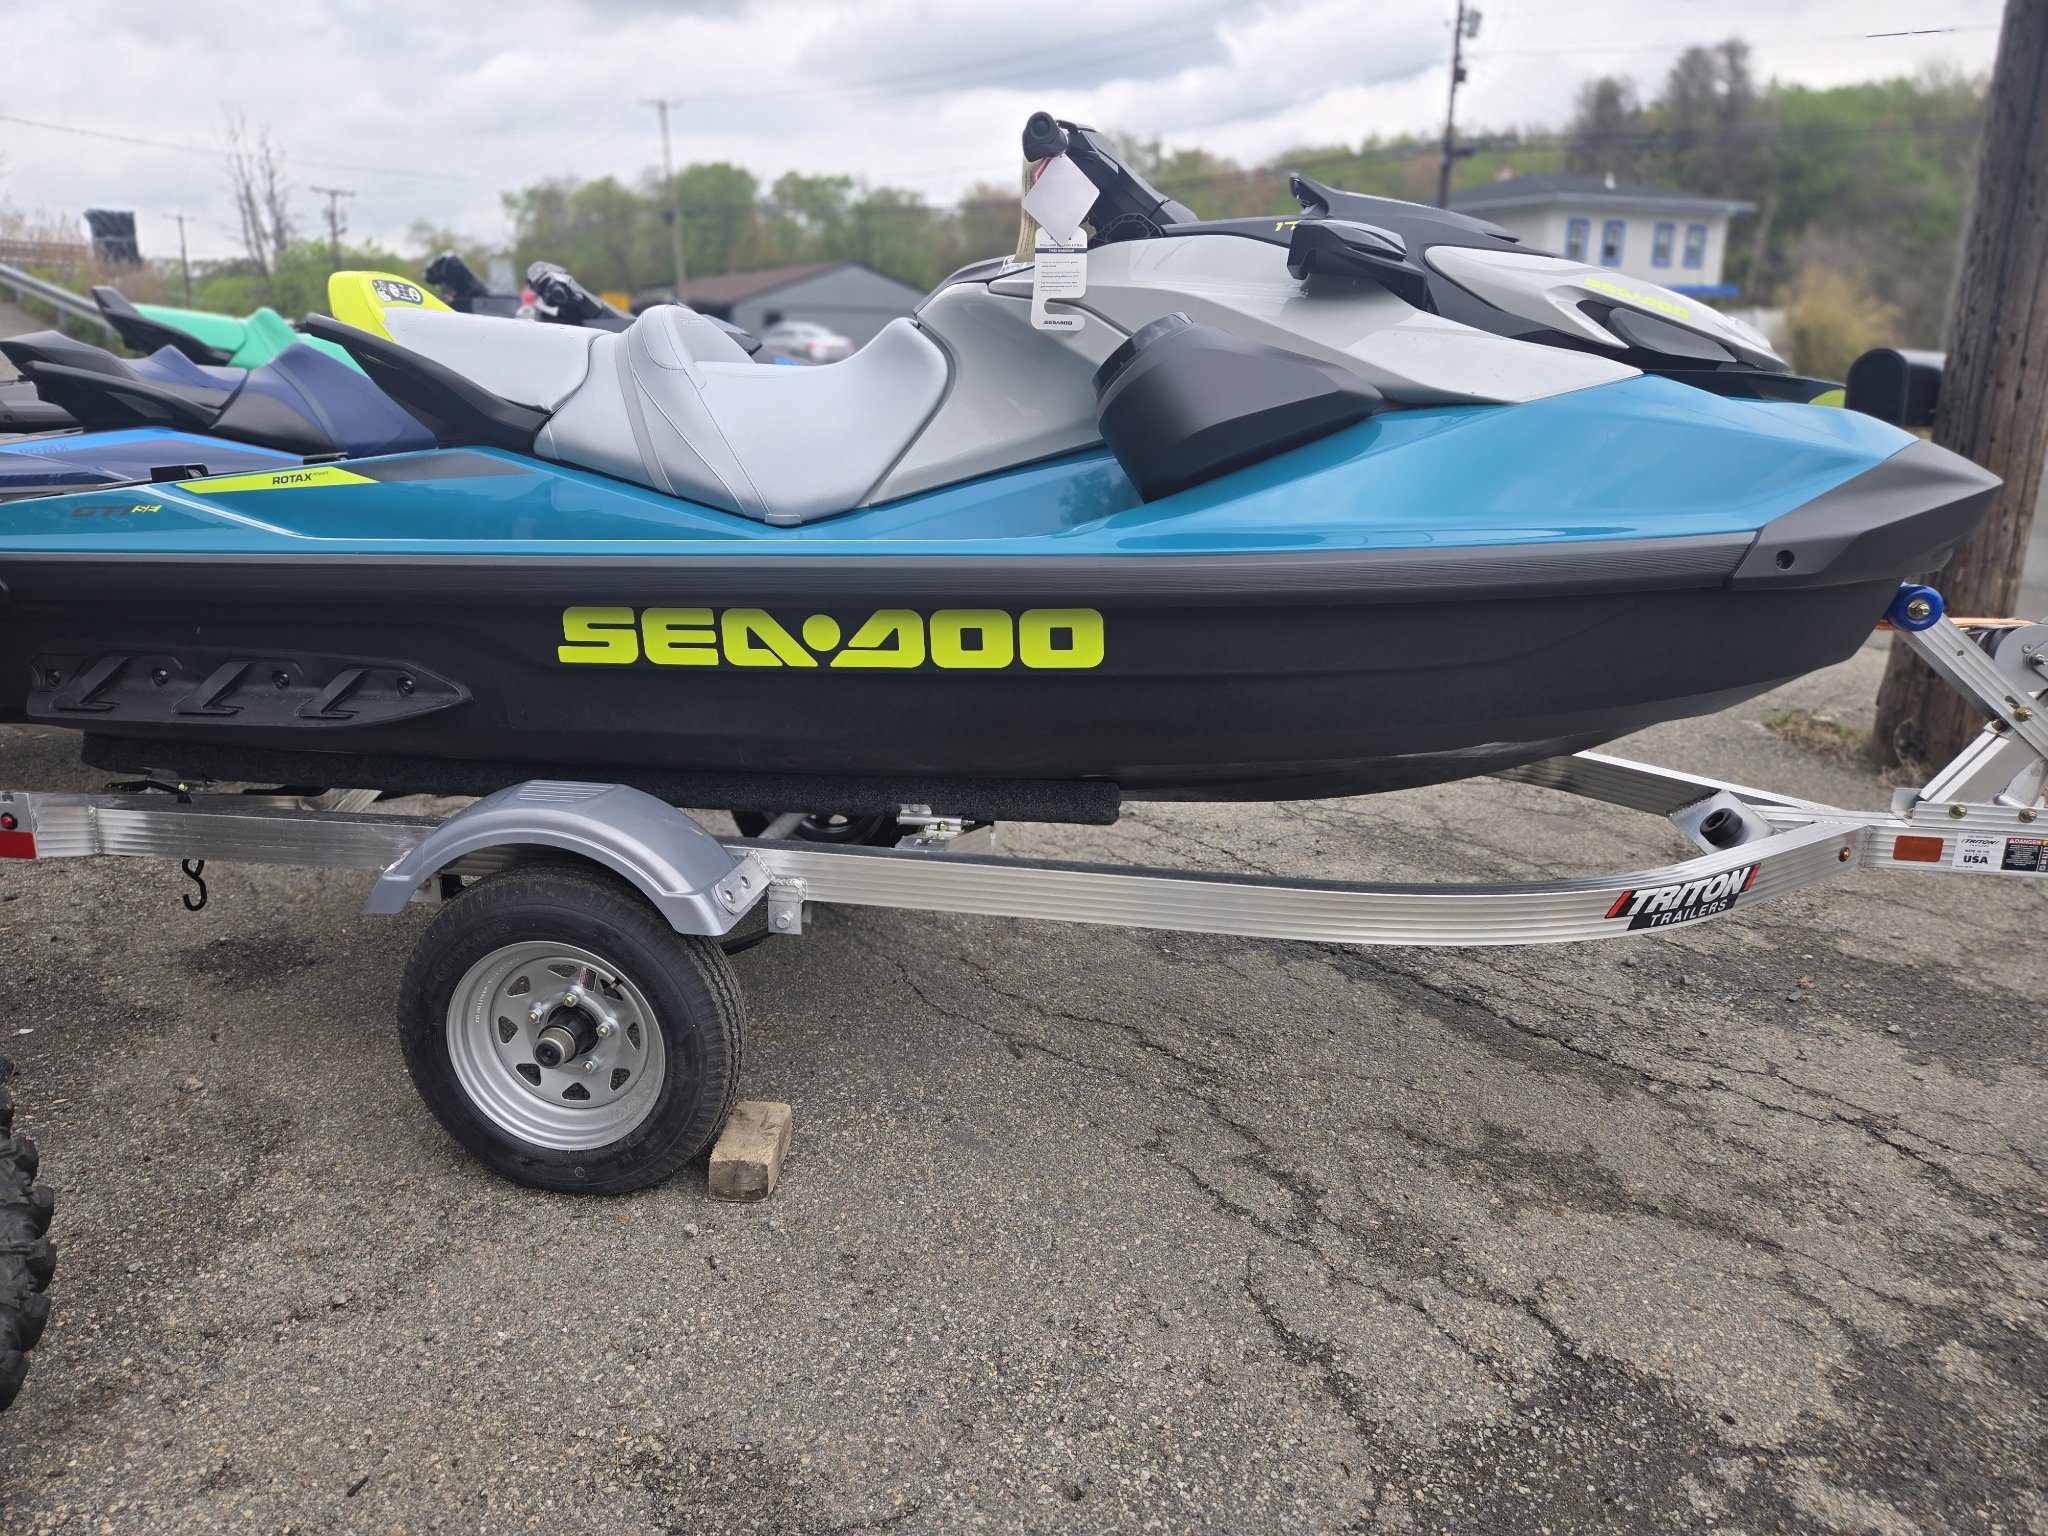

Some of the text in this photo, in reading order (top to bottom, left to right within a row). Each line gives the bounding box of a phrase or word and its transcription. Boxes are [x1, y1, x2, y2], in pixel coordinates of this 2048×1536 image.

[272, 473, 312, 484] ROTAX
[1963, 855, 1988, 864] USA
[1627, 866, 1751, 915] TRITON
[1650, 899, 1728, 926] TRAILERS
